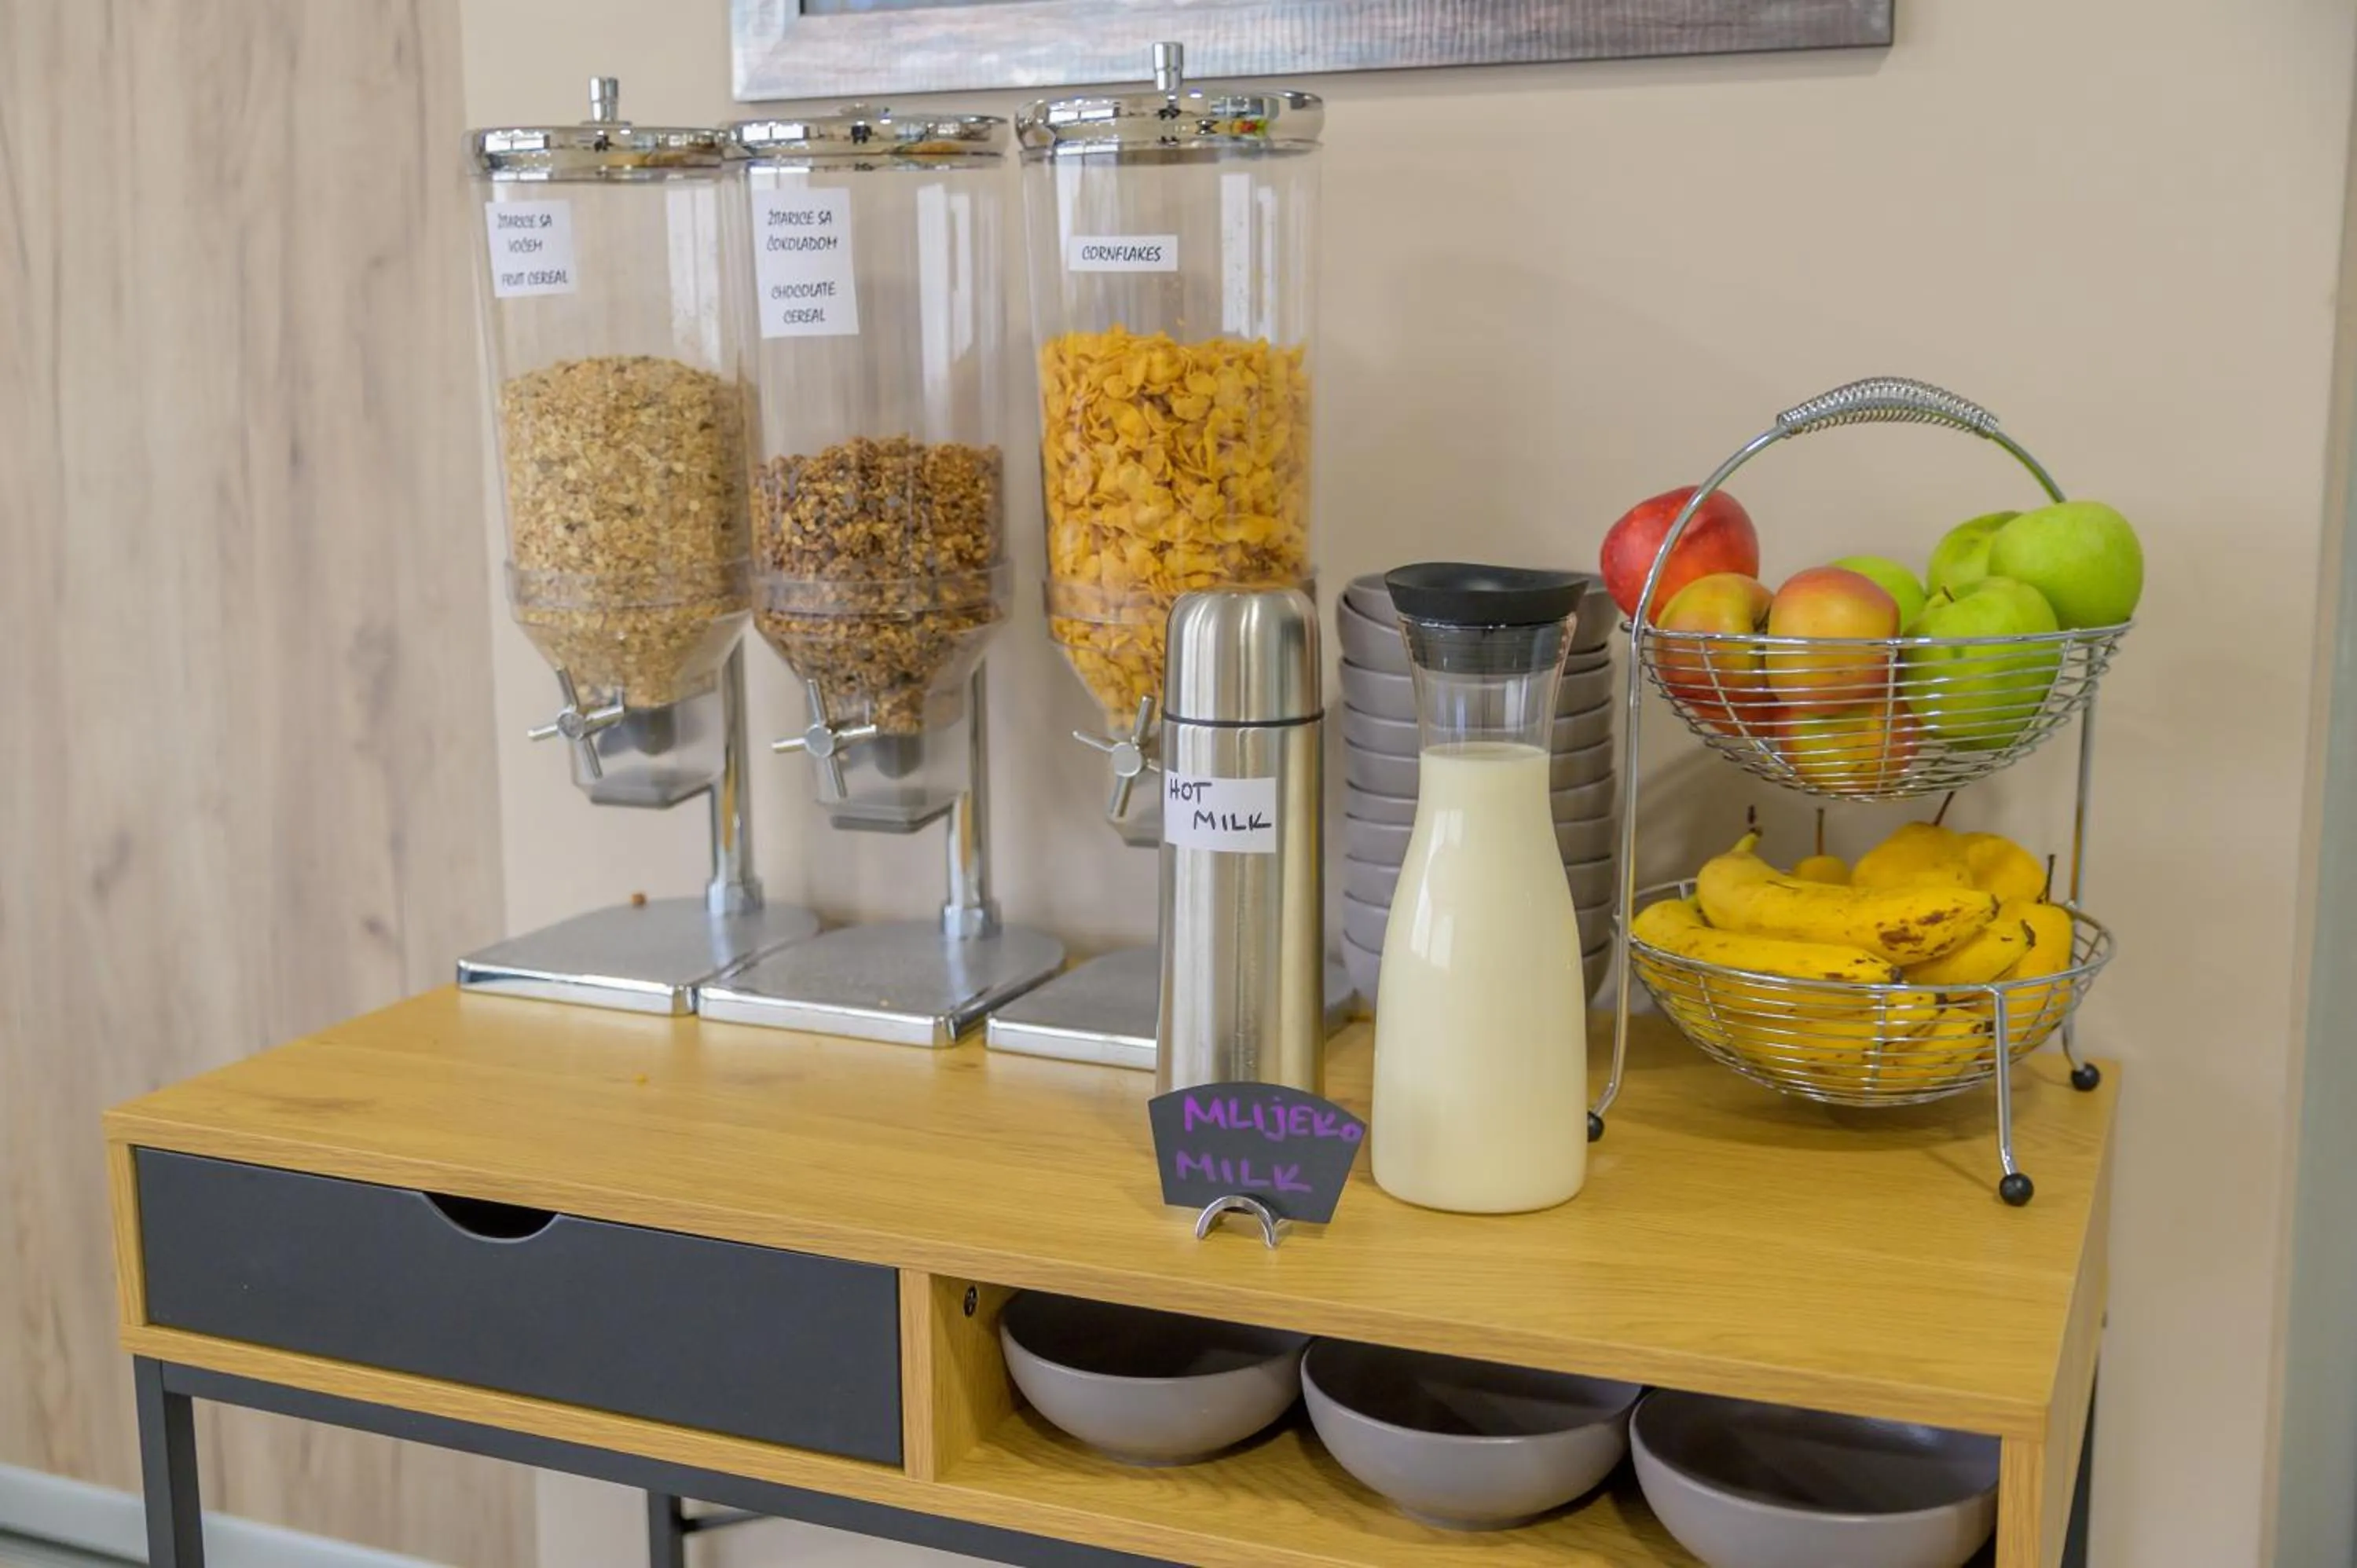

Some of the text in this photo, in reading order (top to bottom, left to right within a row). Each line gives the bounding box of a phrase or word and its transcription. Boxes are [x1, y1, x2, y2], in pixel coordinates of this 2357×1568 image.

[768, 208, 833, 225] ŽITARICE SA
[766, 235, 838, 251] ČOKOLADOM
[1082, 245, 1162, 262] CORNFLAKES
[526, 269, 568, 285] CEREAL
[771, 281, 837, 299] CHOCOLATE
[783, 309, 827, 324] CEREAL
[1169, 779, 1212, 804] HOT
[1193, 809, 1272, 831] MILK
[1176, 1149, 1313, 1192] MILK
